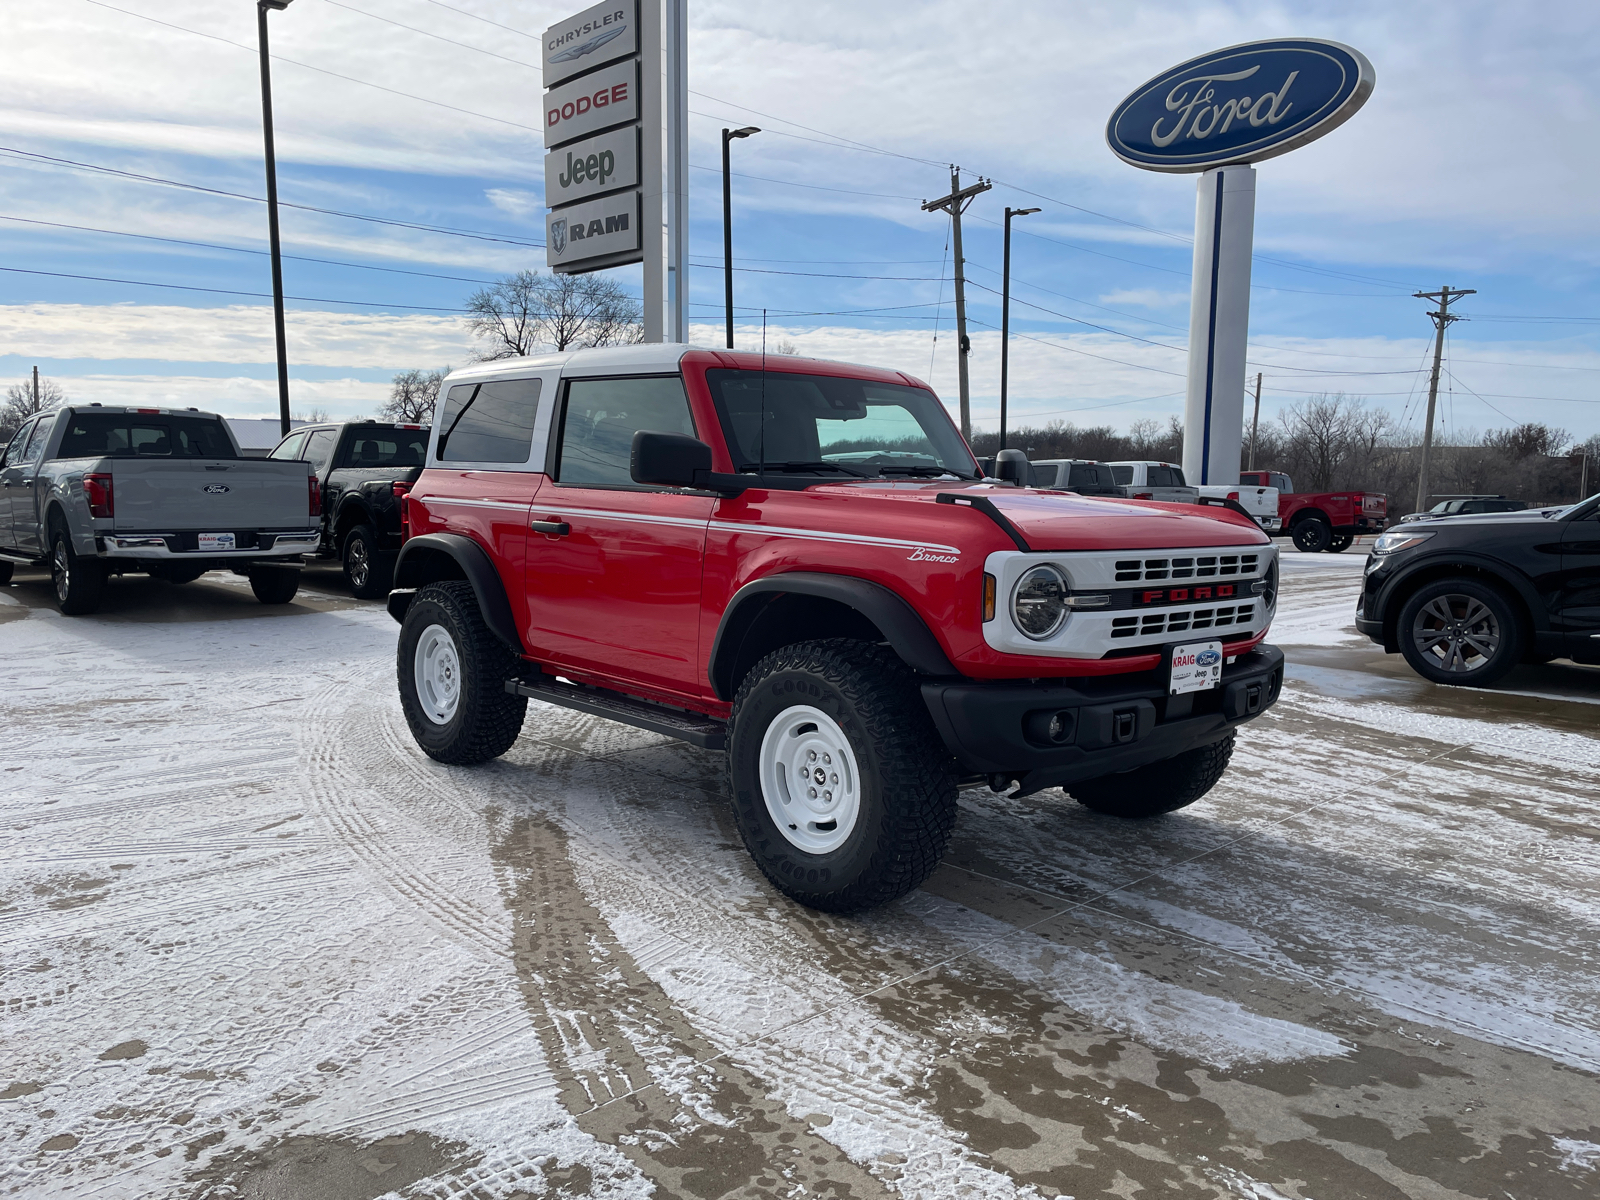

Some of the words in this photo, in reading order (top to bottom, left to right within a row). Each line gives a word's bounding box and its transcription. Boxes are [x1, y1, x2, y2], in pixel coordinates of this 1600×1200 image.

[548, 10, 625, 51] CHRYSLER
[547, 82, 628, 127] DODGE
[1151, 64, 1300, 148] Ford
[559, 149, 615, 189] Jeep
[570, 212, 630, 242] RAM
[207, 485, 226, 493] Ford
[906, 546, 960, 564] Bronco
[1142, 585, 1233, 604] FORD
[1172, 653, 1196, 669] KRAIG
[1194, 669, 1208, 679] Jeep
